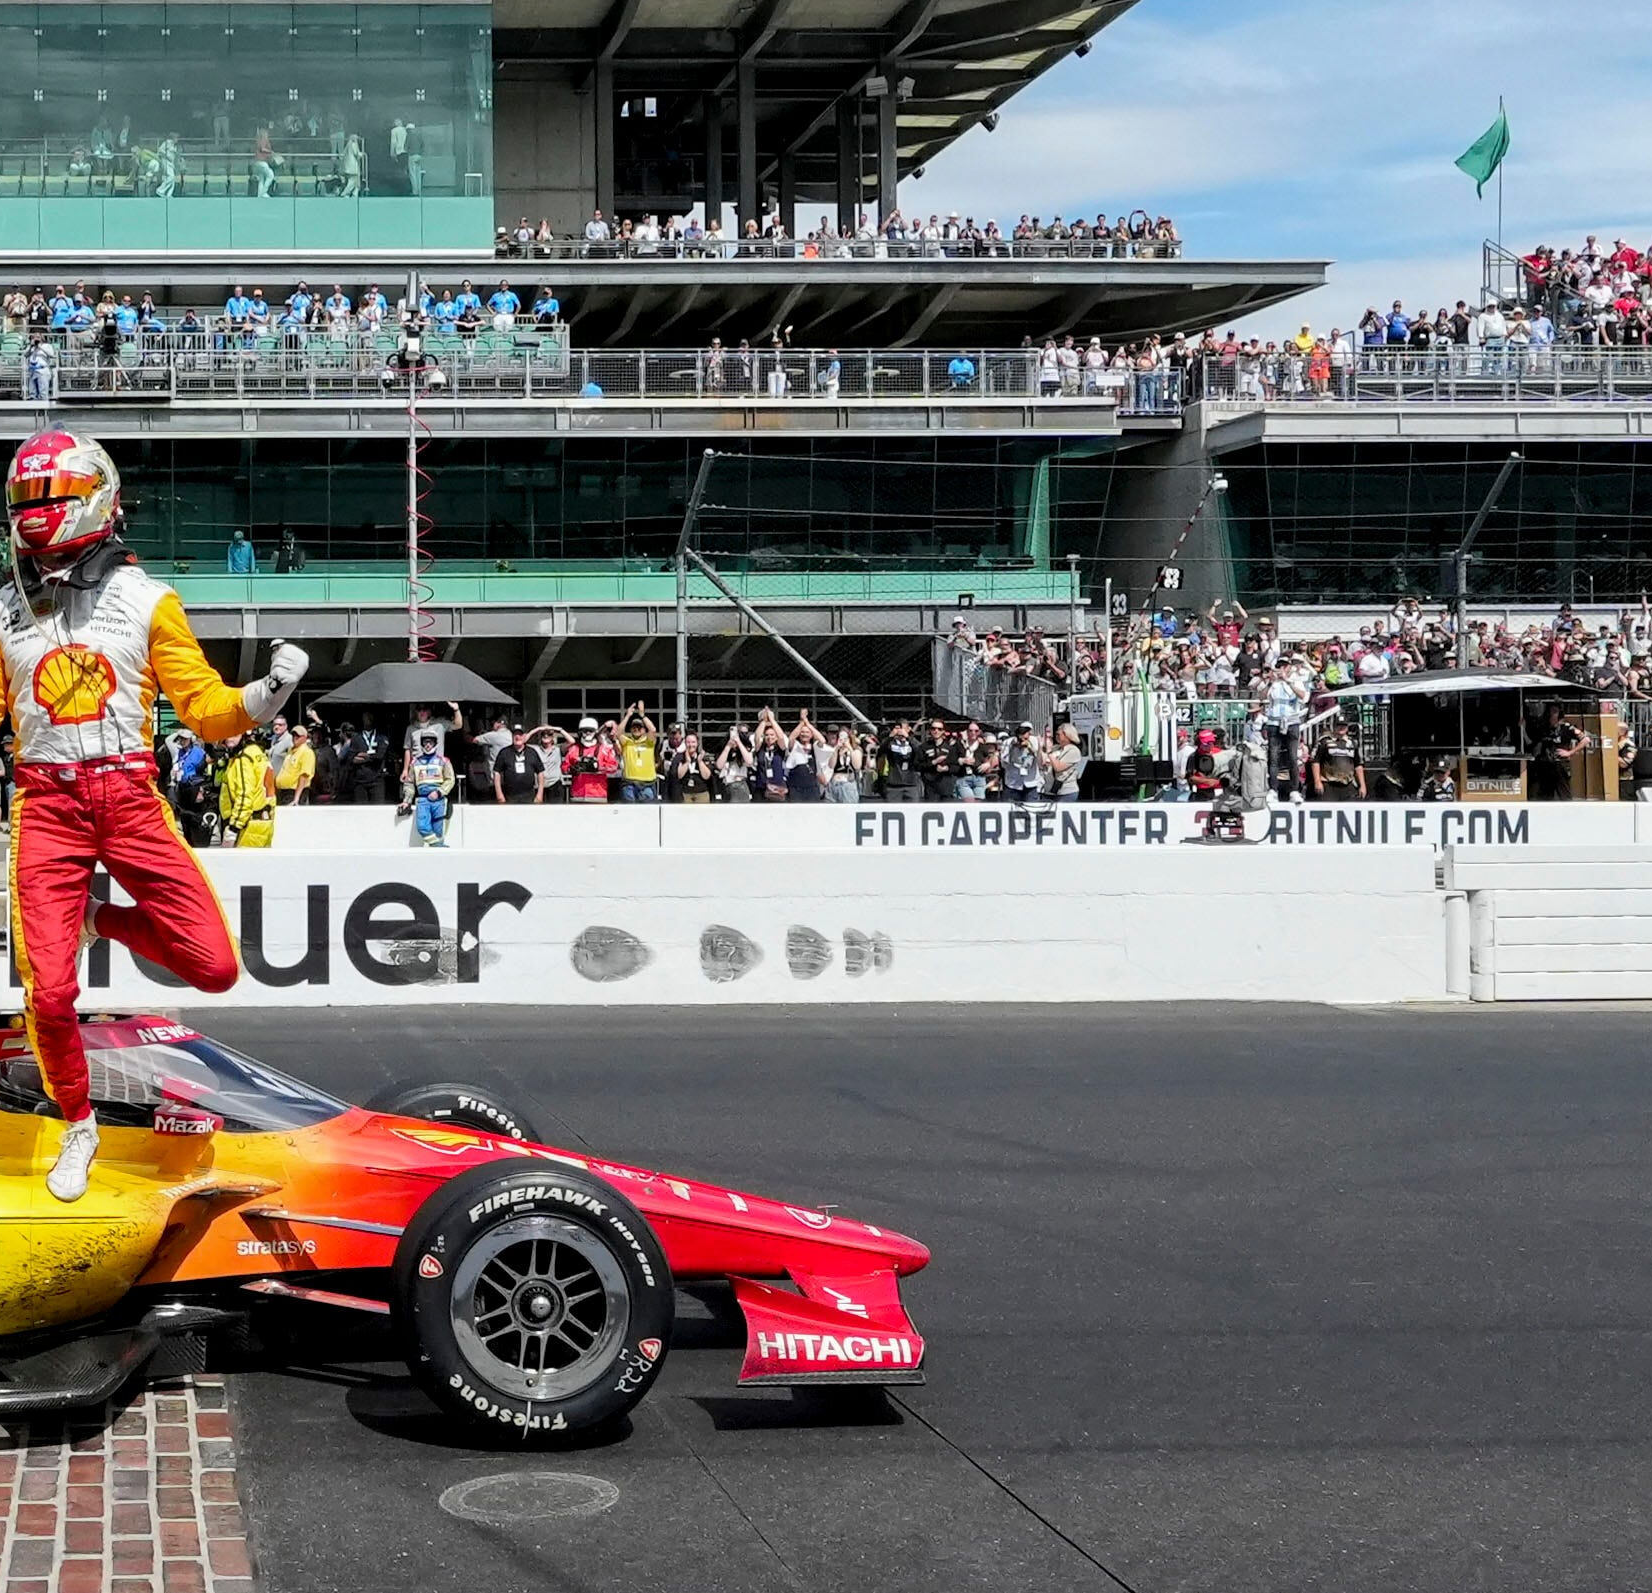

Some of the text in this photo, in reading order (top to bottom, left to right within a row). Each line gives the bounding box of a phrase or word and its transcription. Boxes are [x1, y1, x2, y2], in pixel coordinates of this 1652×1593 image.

[1111, 593, 1127, 615] 33
[90, 625, 132, 638] HITACHI
[1467, 779, 1521, 792] BITNILE
[922, 810, 1168, 846] CARPENTER
[154, 1114, 216, 1134] Mazak
[468, 1186, 609, 1224] FIREHAWK
[236, 1239, 316, 1258] stratasys
[756, 1331, 913, 1364] HITACHI
[449, 1372, 568, 1431] Firestone
